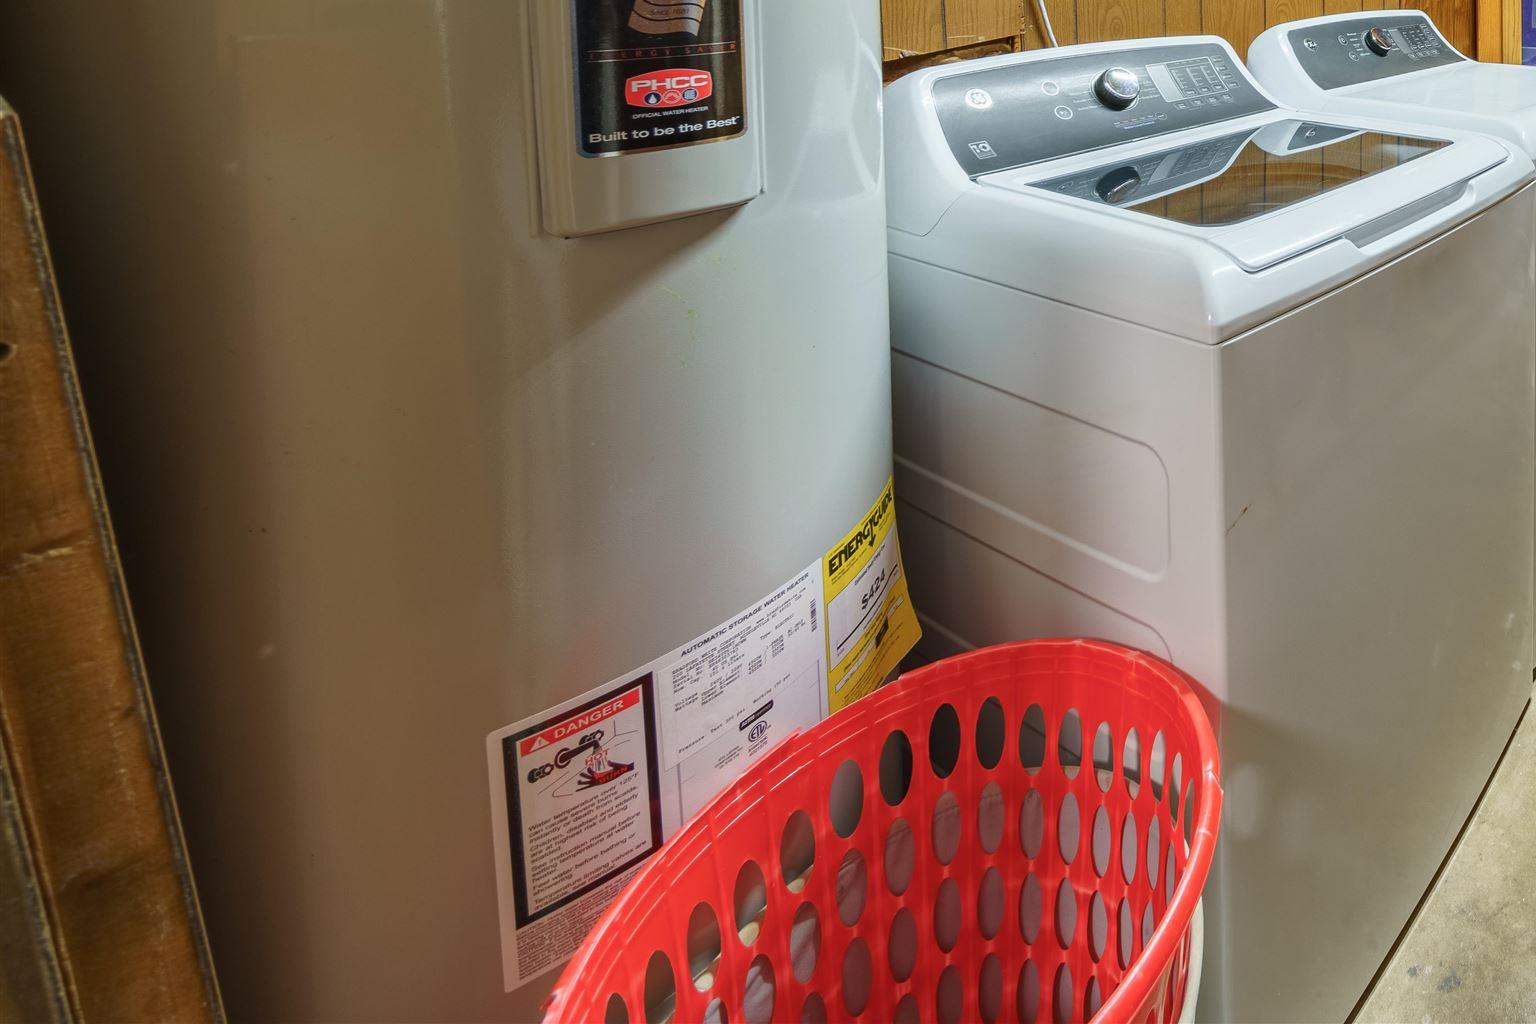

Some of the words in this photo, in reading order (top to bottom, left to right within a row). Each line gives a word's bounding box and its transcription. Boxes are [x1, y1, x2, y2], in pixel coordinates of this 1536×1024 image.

[588, 48, 672, 60] EERGY
[631, 73, 709, 92] PHCC
[588, 132, 628, 144] Built
[632, 129, 650, 139] to
[653, 127, 675, 137] be
[678, 122, 703, 134] the
[706, 117, 738, 130] Best
[631, 111, 662, 120] OFFICIAL
[662, 108, 685, 117] WATER
[685, 105, 709, 114] HEATER
[681, 627, 727, 657] AUTOMATIC
[728, 605, 763, 631] STORAGE
[764, 589, 786, 608] WATER
[553, 699, 625, 739] DANGER
[585, 747, 610, 768] HOT
[527, 816, 551, 832] Water
[553, 793, 598, 821] temperature
[600, 785, 616, 796] over
[528, 824, 561, 844] instantly
[572, 807, 593, 823] death
[595, 798, 612, 811] from
[544, 814, 568, 830] cause
[570, 801, 595, 817] severe
[597, 789, 618, 804] burns
[544, 842, 552, 850] at
[554, 827, 582, 847] highest
[583, 820, 596, 831] risk
[598, 814, 605, 823] of
[607, 803, 628, 818] being
[566, 813, 597, 834] disabled
[599, 805, 613, 817] and
[614, 791, 638, 808] elderly
[531, 860, 547, 873] See
[548, 839, 588, 864] instruction
[589, 823, 616, 843] manual
[617, 810, 640, 827] before
[551, 866, 572, 882] water
[574, 852, 598, 870] before
[600, 836, 627, 855] bathing
[627, 831, 636, 839] or
[559, 835, 604, 864] temperature
[605, 830, 613, 839] at
[614, 819, 634, 834] water
[534, 876, 582, 906] Temperature
[583, 860, 609, 879] limiting
[611, 847, 633, 864] valves
